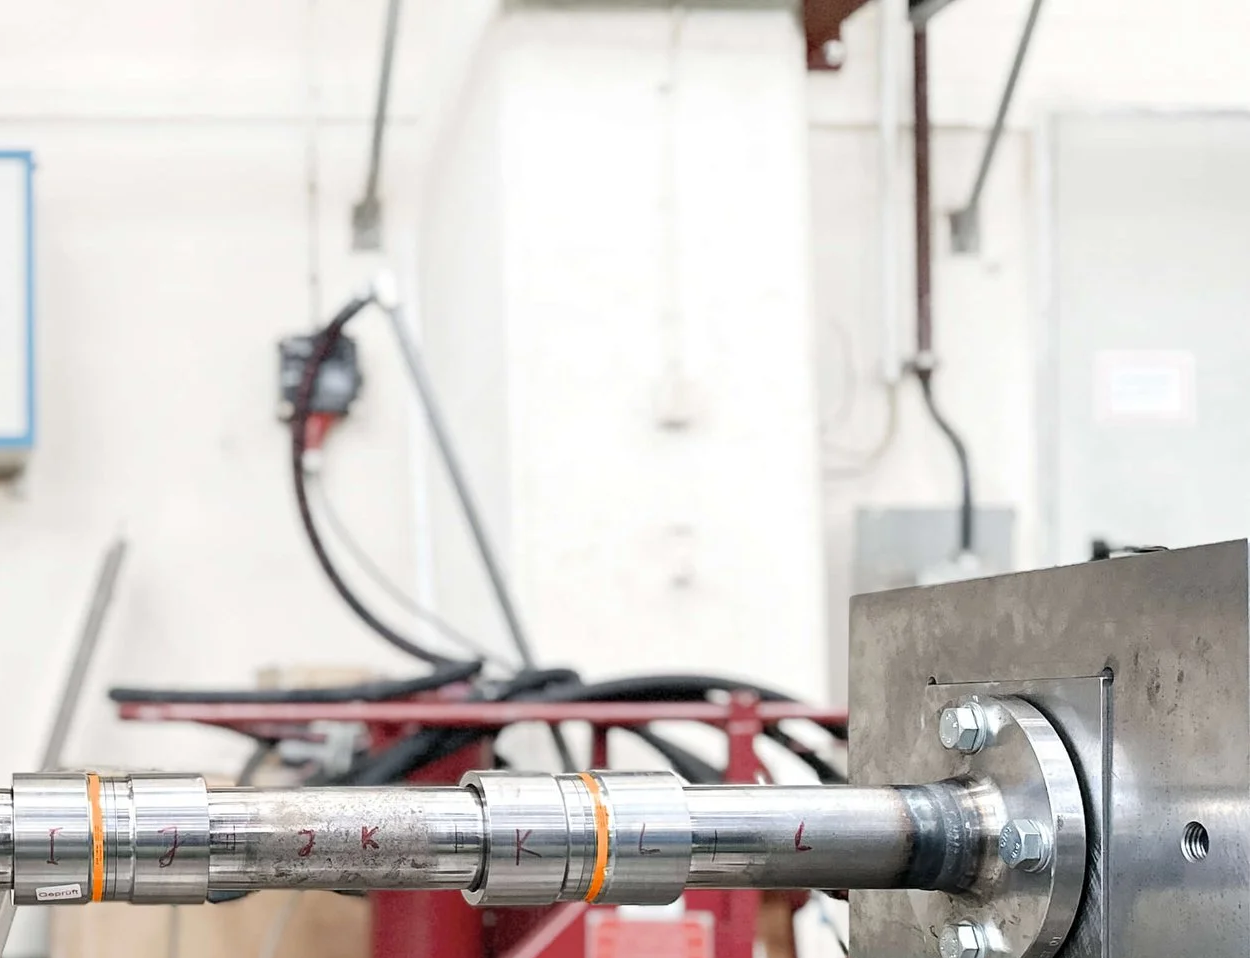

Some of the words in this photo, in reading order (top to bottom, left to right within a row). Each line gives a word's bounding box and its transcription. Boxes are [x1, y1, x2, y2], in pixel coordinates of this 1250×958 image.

[47, 827, 63, 865] I
[361, 826, 379, 850] K
[516, 828, 542, 866] K
[639, 822, 660, 855] L
[794, 821, 813, 852] L
[38, 889, 79, 898] Geprüft
